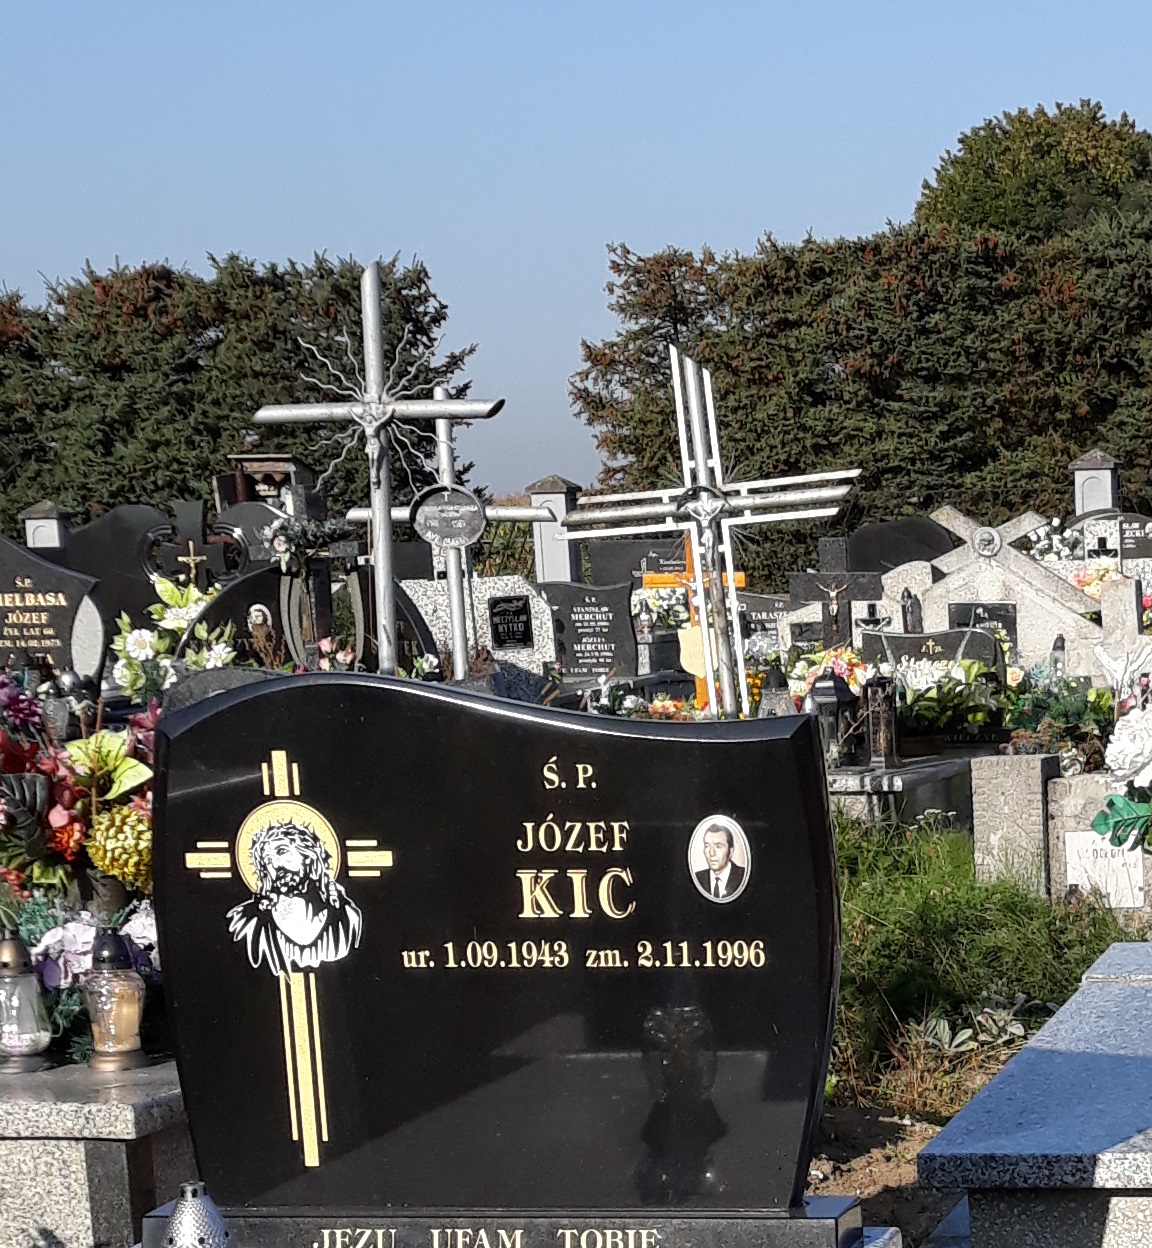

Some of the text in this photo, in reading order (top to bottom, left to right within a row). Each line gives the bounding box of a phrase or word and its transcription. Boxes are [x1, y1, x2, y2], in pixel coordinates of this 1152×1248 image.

[4, 609, 49, 624] JÓZEF
[542, 755, 598, 790] Ś. P.
[515, 812, 631, 854] JÓZEF
[515, 867, 637, 920] KIC
[401, 939, 766, 969] ur. 1.09.1943 zm. 2.11.1996
